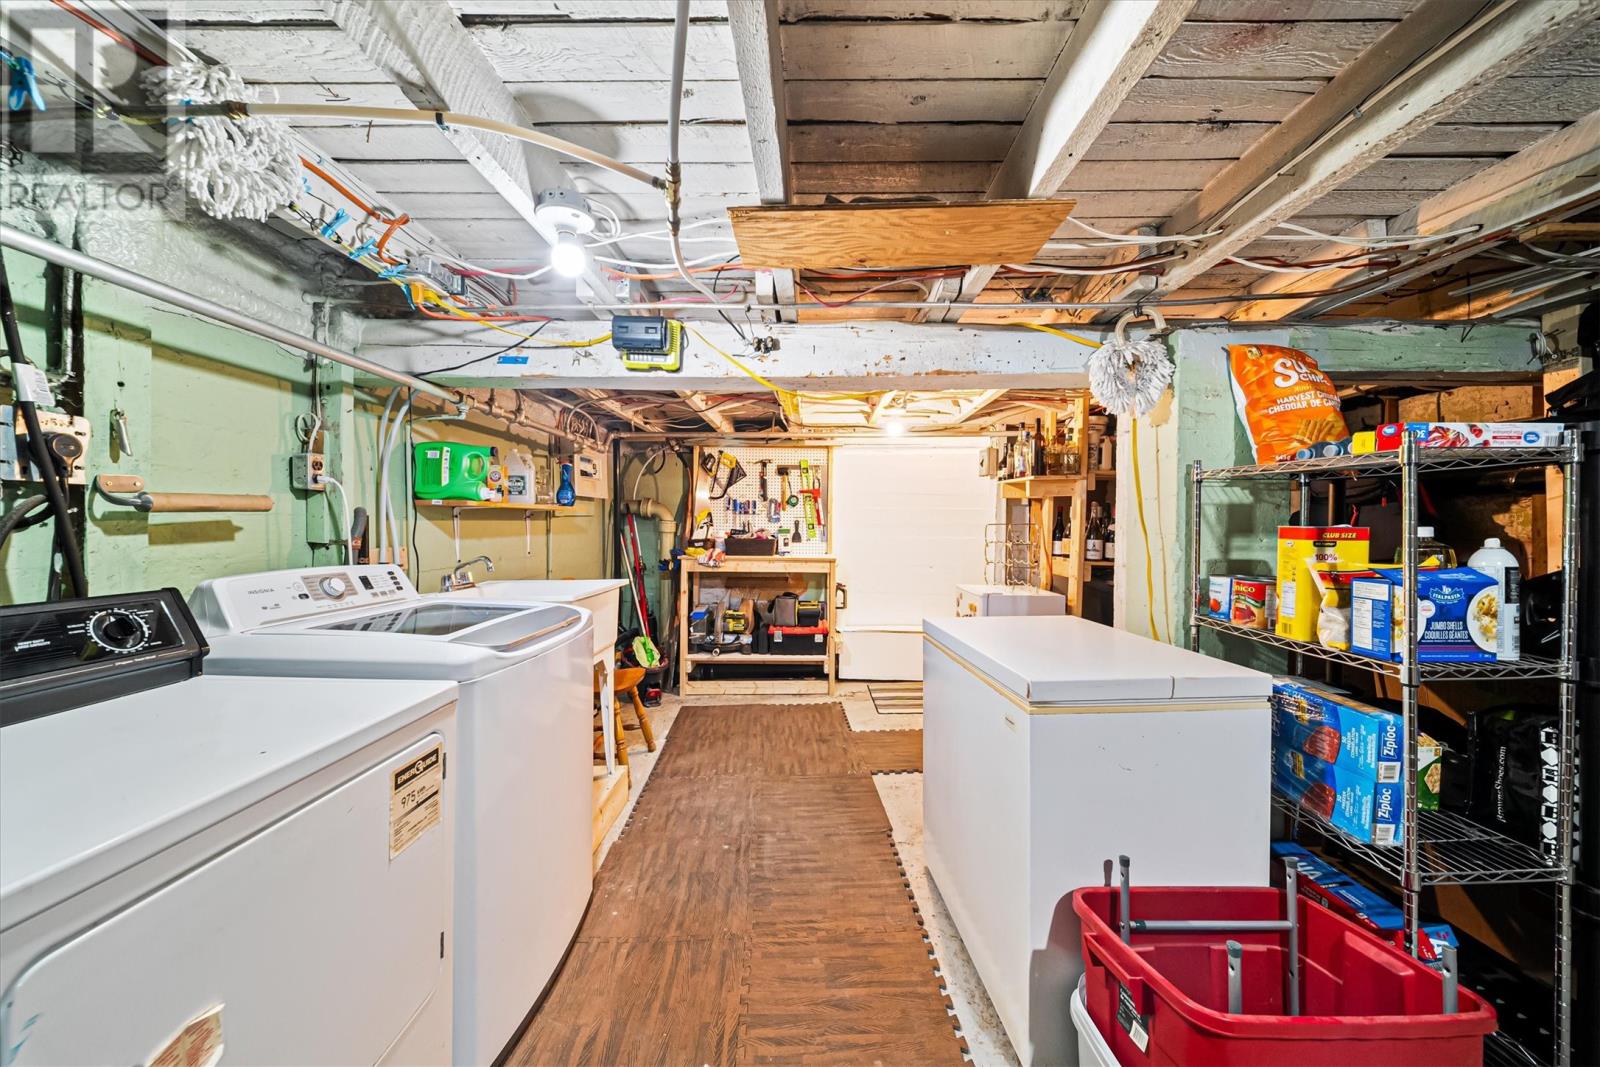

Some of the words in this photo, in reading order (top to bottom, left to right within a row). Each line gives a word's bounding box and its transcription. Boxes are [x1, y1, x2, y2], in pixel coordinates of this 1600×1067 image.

[1276, 390, 1315, 404] HARVEST
[1268, 401, 1308, 415] CHEDDAR
[1310, 398, 1322, 408] DE
[1314, 553, 1338, 561] 100%
[1234, 583, 1256, 593] nico
[1430, 621, 1447, 630] JUMBO
[1446, 621, 1464, 630] SHELLS
[1424, 630, 1448, 640] COQUILLES
[1448, 629, 1469, 639] GÉANTES
[1383, 725, 1397, 756] Ziploc
[401, 789, 416, 809] 975
[1378, 788, 1392, 818] Ziploc
